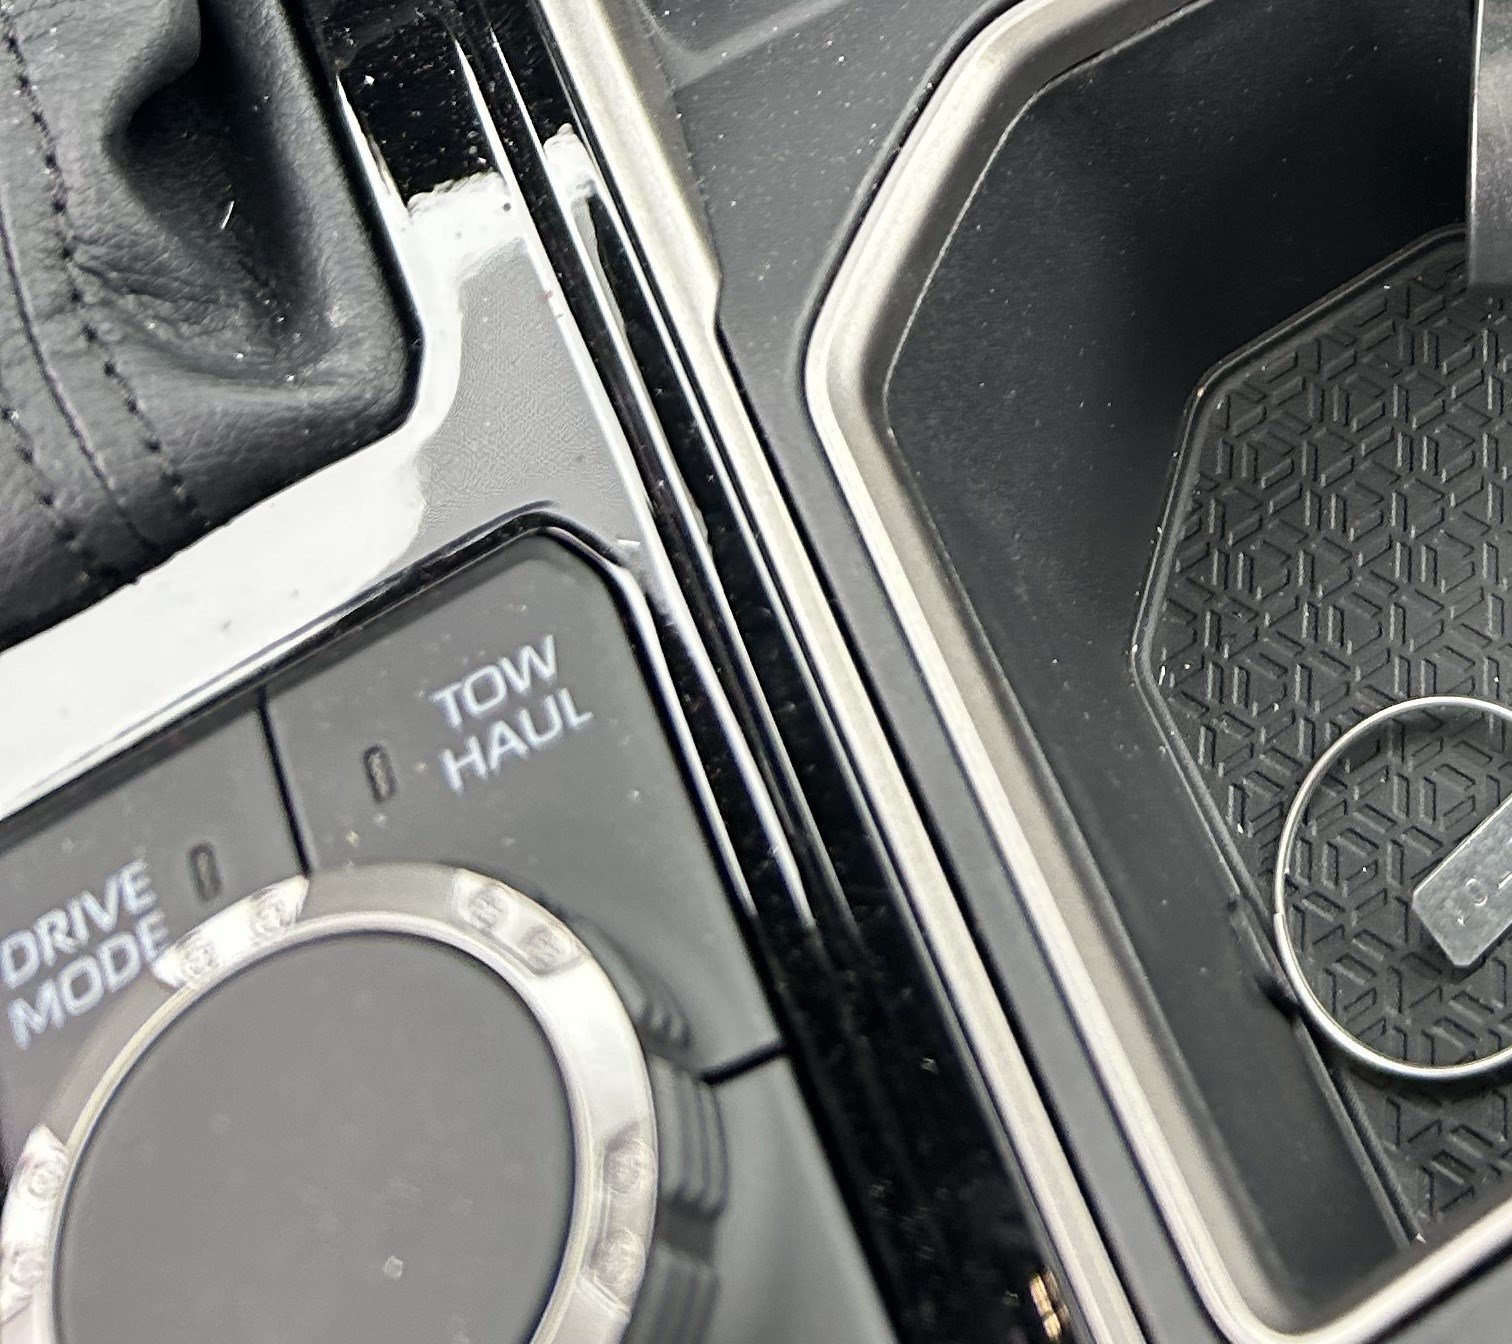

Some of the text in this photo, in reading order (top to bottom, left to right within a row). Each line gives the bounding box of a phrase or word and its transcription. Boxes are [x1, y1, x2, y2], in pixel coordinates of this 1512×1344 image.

[428, 633, 558, 732] TOW
[437, 687, 594, 796] HAUL
[0, 857, 157, 990] DRIVE
[7, 908, 170, 1051] MODE
